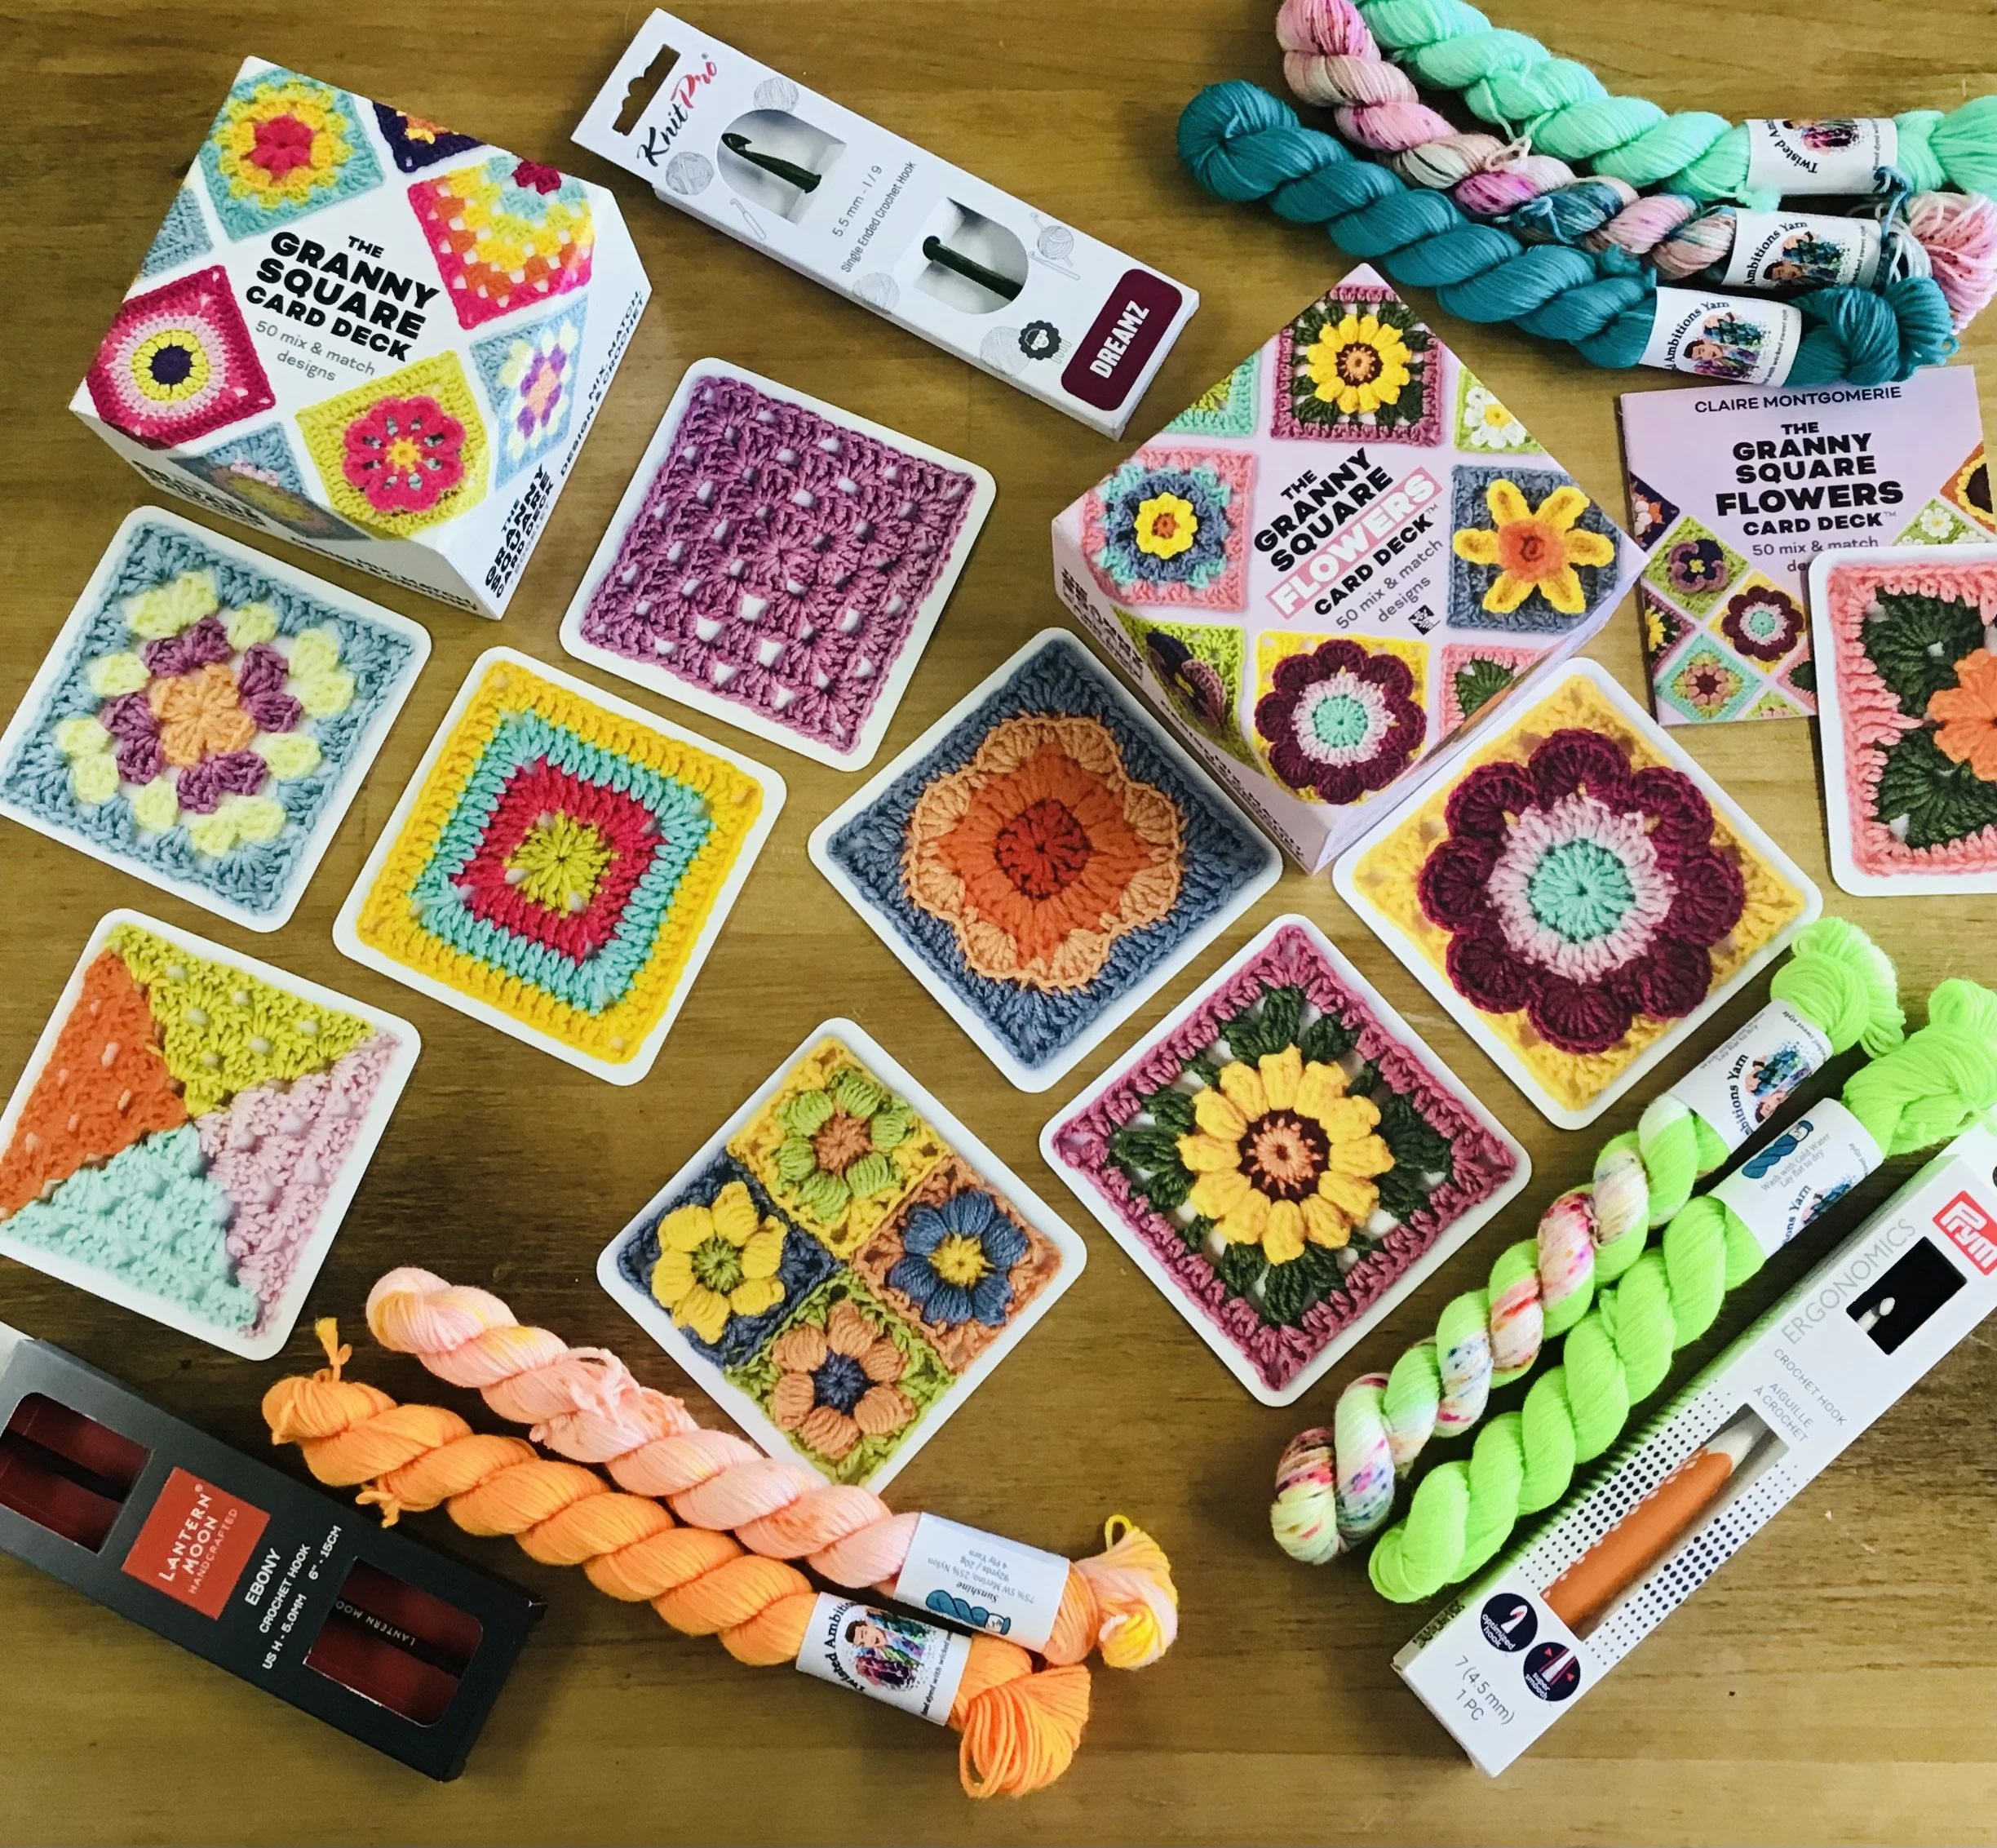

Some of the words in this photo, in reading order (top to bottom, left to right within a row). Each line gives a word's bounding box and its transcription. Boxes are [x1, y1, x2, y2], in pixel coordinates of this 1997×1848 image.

[1774, 140, 1818, 174] Twisted
[841, 246, 863, 273] Single
[858, 217, 881, 246] Ended
[875, 184, 902, 219] Crochet
[897, 162, 917, 184] Hook
[847, 196, 865, 218] mm
[348, 235, 384, 259] THE
[1744, 230, 1781, 285] Ambitions
[1778, 220, 1809, 232] Yarn
[271, 232, 441, 309] GRANNY
[256, 258, 427, 340] SQUARE
[246, 286, 326, 327] CARD
[330, 317, 413, 362] DECK
[1089, 299, 1150, 379] DREAMZ
[1664, 308, 1702, 362] Ambitions
[1701, 302, 1730, 311] Yarn
[255, 320, 278, 337] 50
[280, 330, 307, 350] mix
[311, 342, 323, 356] &
[326, 348, 376, 376] match
[277, 351, 336, 382] designs
[560, 405, 595, 476] DESIGN
[603, 296, 643, 385] CROCHET
[1694, 397, 1760, 414] CLAIRE
[1764, 386, 1902, 408] MONTGOMERIE
[1733, 432, 1872, 461] GRANNY
[1781, 422, 1819, 435] THE
[1281, 469, 1318, 500] THE
[1735, 455, 1877, 484] SQUARE
[501, 498, 520, 533] THE
[1254, 447, 1371, 552] GRANNY
[1270, 466, 1393, 572] SQUARE
[1716, 481, 1904, 516] FLOWERS
[485, 463, 543, 587] GRANNY
[491, 472, 551, 593] SQUARE
[496, 540, 525, 598] CARD
[526, 481, 554, 537] DECK
[1270, 474, 1435, 615] FLOWERS
[1742, 518, 1810, 536] CARD
[1752, 543, 1774, 556] 50
[1779, 542, 1806, 555] mix
[1811, 540, 1823, 552] &
[1314, 564, 1374, 615] CARD
[1336, 609, 1358, 629] 50
[1360, 588, 1385, 613] mix
[1384, 577, 1399, 590] &
[1399, 538, 1443, 579] match
[1379, 577, 1431, 623] designs
[1727, 1053, 1749, 1081] Yarn
[1729, 1084, 1754, 1136] mbitions
[1760, 1174, 1781, 1191] Wash
[1780, 1162, 1796, 1177] with
[1795, 1148, 1813, 1163] Cold
[1809, 1133, 1831, 1151] Water
[1778, 1174, 1795, 1189] Lay
[1803, 1159, 1813, 1169] to
[1810, 1150, 1826, 1164] dry
[1789, 1185, 1813, 1212] Yarn
[1781, 1219, 1916, 1345] ERGONOMICS
[1769, 1383, 1813, 1428] AIGUILLE
[1773, 1349, 1821, 1395] CROCHET
[1818, 1395, 1848, 1426] HOOK
[1762, 1395, 1809, 1443] CROCHET
[158, 1494, 212, 1582] LANTERN
[182, 1516, 219, 1575] MOON
[188, 1508, 238, 1594] HANDCRAFTED
[969, 1550, 986, 1562] Yarn
[245, 1548, 281, 1606] EBONY
[928, 1557, 950, 1573] Nylon
[952, 1565, 970, 1580] 25%
[960, 1555, 976, 1569] 20g
[982, 1567, 1010, 1582] 92yrds
[989, 1556, 1001, 1567] Ply
[259, 1577, 292, 1633] CROCHET
[287, 1544, 311, 1578] HOOK
[262, 1651, 277, 1669] US
[272, 1640, 283, 1652] H
[281, 1593, 307, 1633] 5.0MM
[320, 1525, 342, 1558] 15CM
[335, 1600, 363, 1619] MOO
[956, 1581, 999, 1603] Sunshine
[1002, 1586, 1016, 1597] SW
[1017, 1590, 1035, 1604] 75%
[366, 1615, 415, 1646] LANTERN
[825, 1600, 858, 1649] Ambiti
[1482, 1614, 1516, 1651] optimized
[1484, 1625, 1501, 1647] hook
[1455, 1655, 1469, 1669] 7
[1462, 1666, 1490, 1695] (4.5
[1485, 1693, 1515, 1726] mm)
[1525, 1673, 1548, 1700] smooth
[1533, 1673, 1550, 1691] super
[1455, 1689, 1467, 1701] 1
[1463, 1698, 1485, 1722] PC
